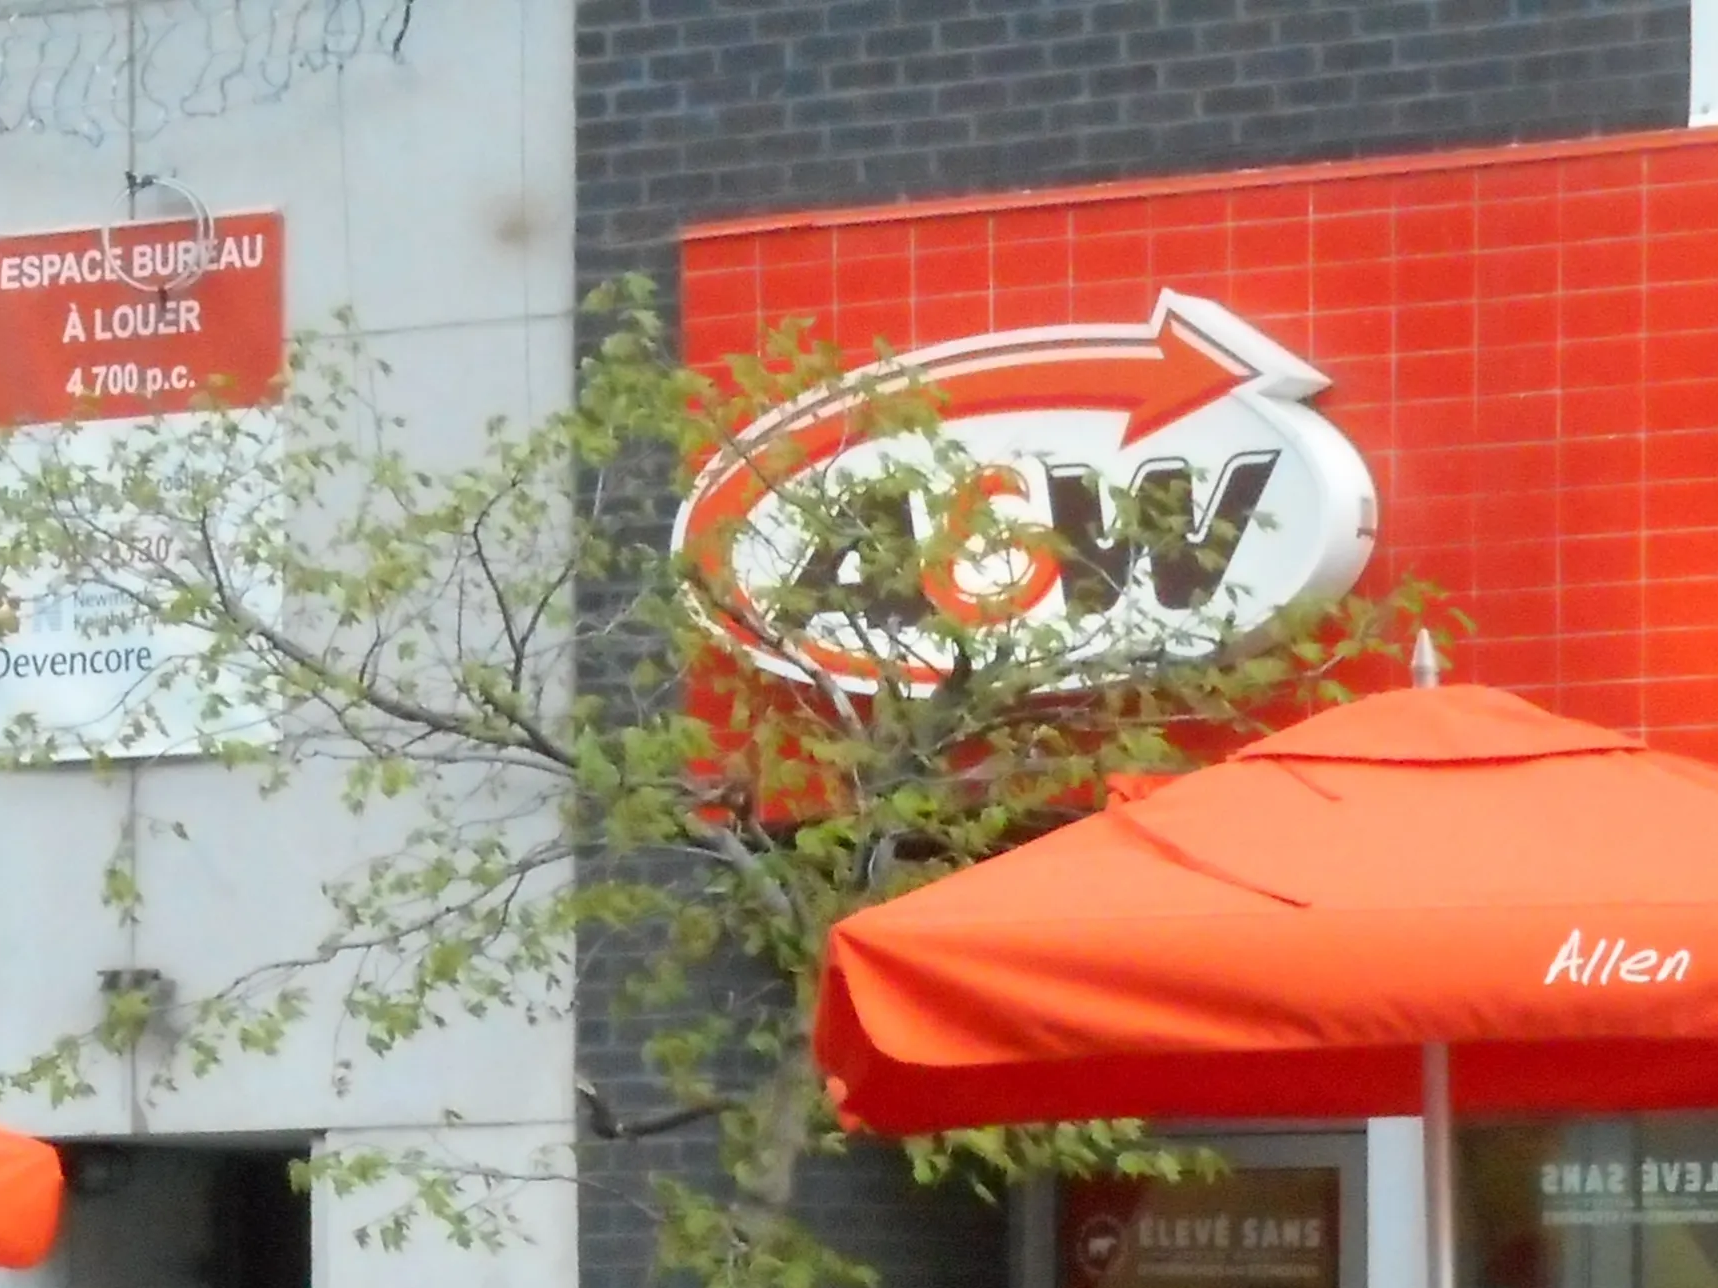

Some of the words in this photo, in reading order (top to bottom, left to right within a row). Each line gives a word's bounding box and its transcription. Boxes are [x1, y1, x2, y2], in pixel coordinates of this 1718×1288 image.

[0, 247, 123, 289] ESPACE
[133, 234, 264, 278] BUREAU
[62, 303, 86, 343] À
[94, 300, 201, 341] LOUER
[147, 365, 196, 398] p.c.
[1544, 928, 1690, 985] Allen
[1241, 1216, 1321, 1249] SANS
